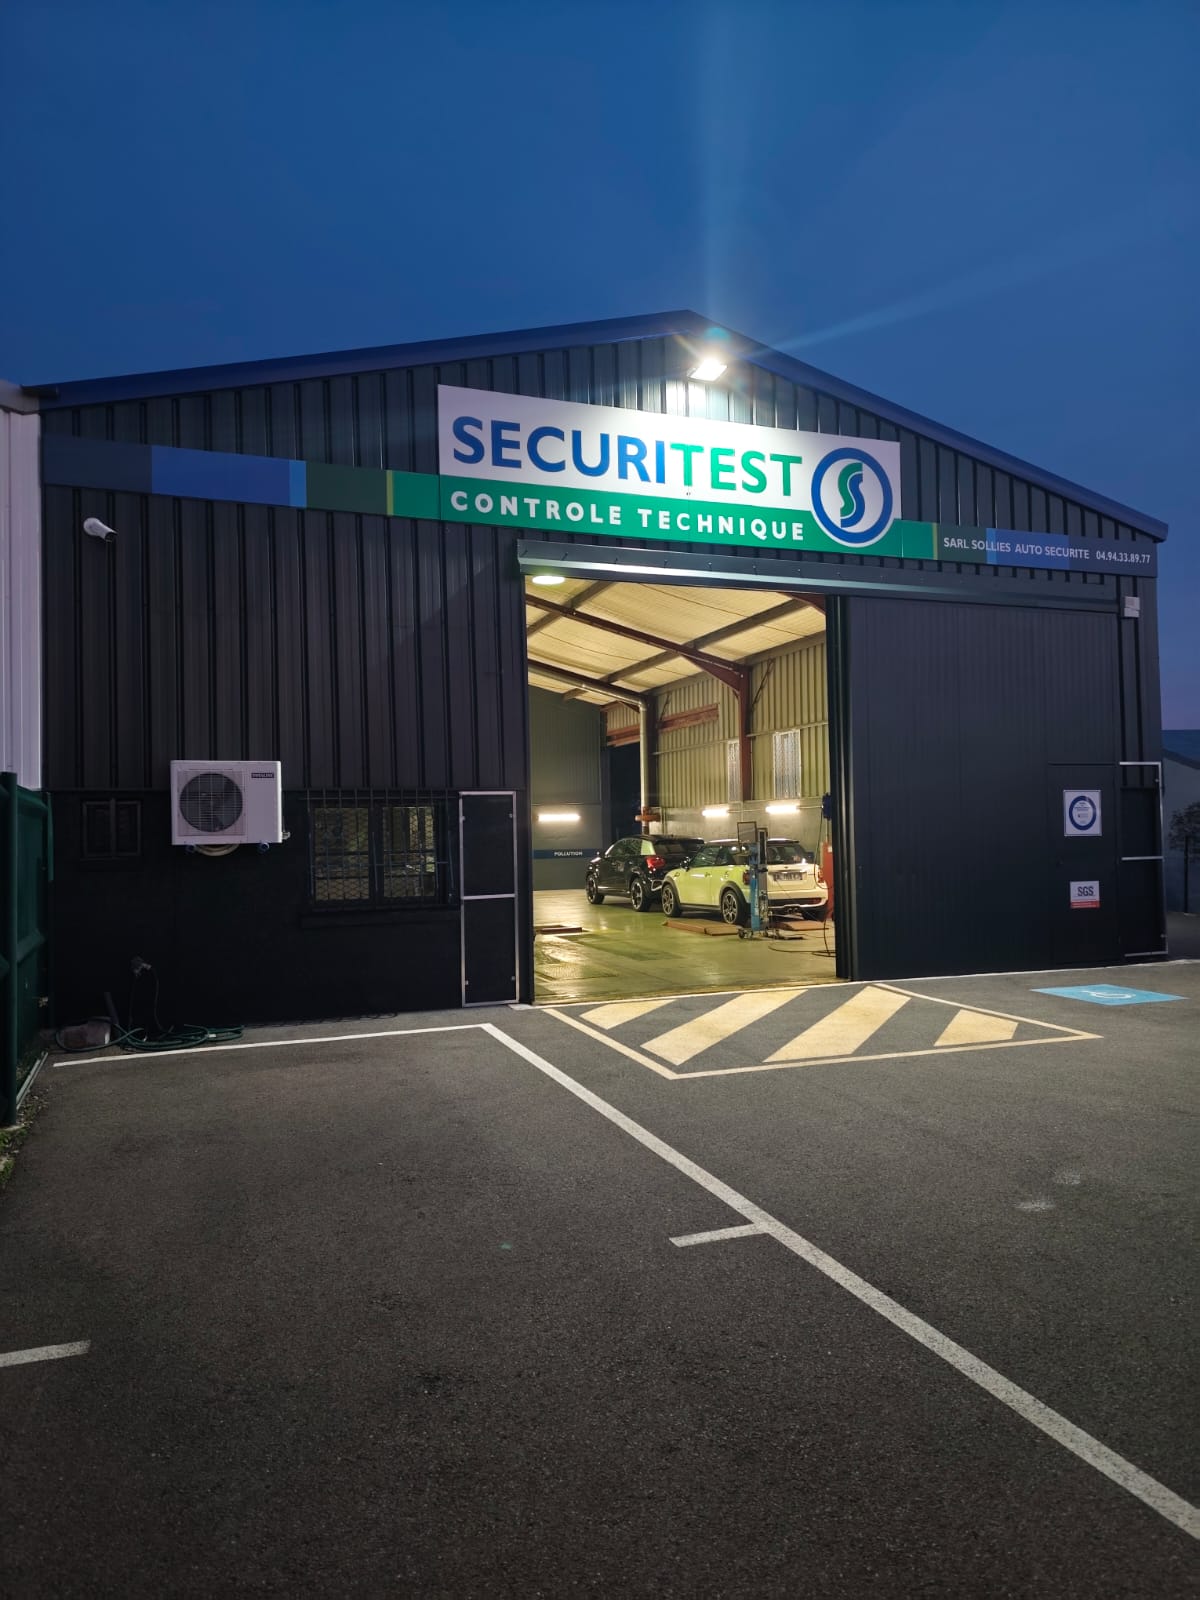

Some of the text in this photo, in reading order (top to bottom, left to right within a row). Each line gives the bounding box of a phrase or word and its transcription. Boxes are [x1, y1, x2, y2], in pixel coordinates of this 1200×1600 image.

[452, 416, 803, 496] SECURITEST
[450, 490, 804, 541] CONTROLE TECHNIQUE
[943, 537, 1151, 564] SARL SOLLIES AUTO SECURITE 04.94.33.89.77
[1077, 886, 1095, 897] SGS
